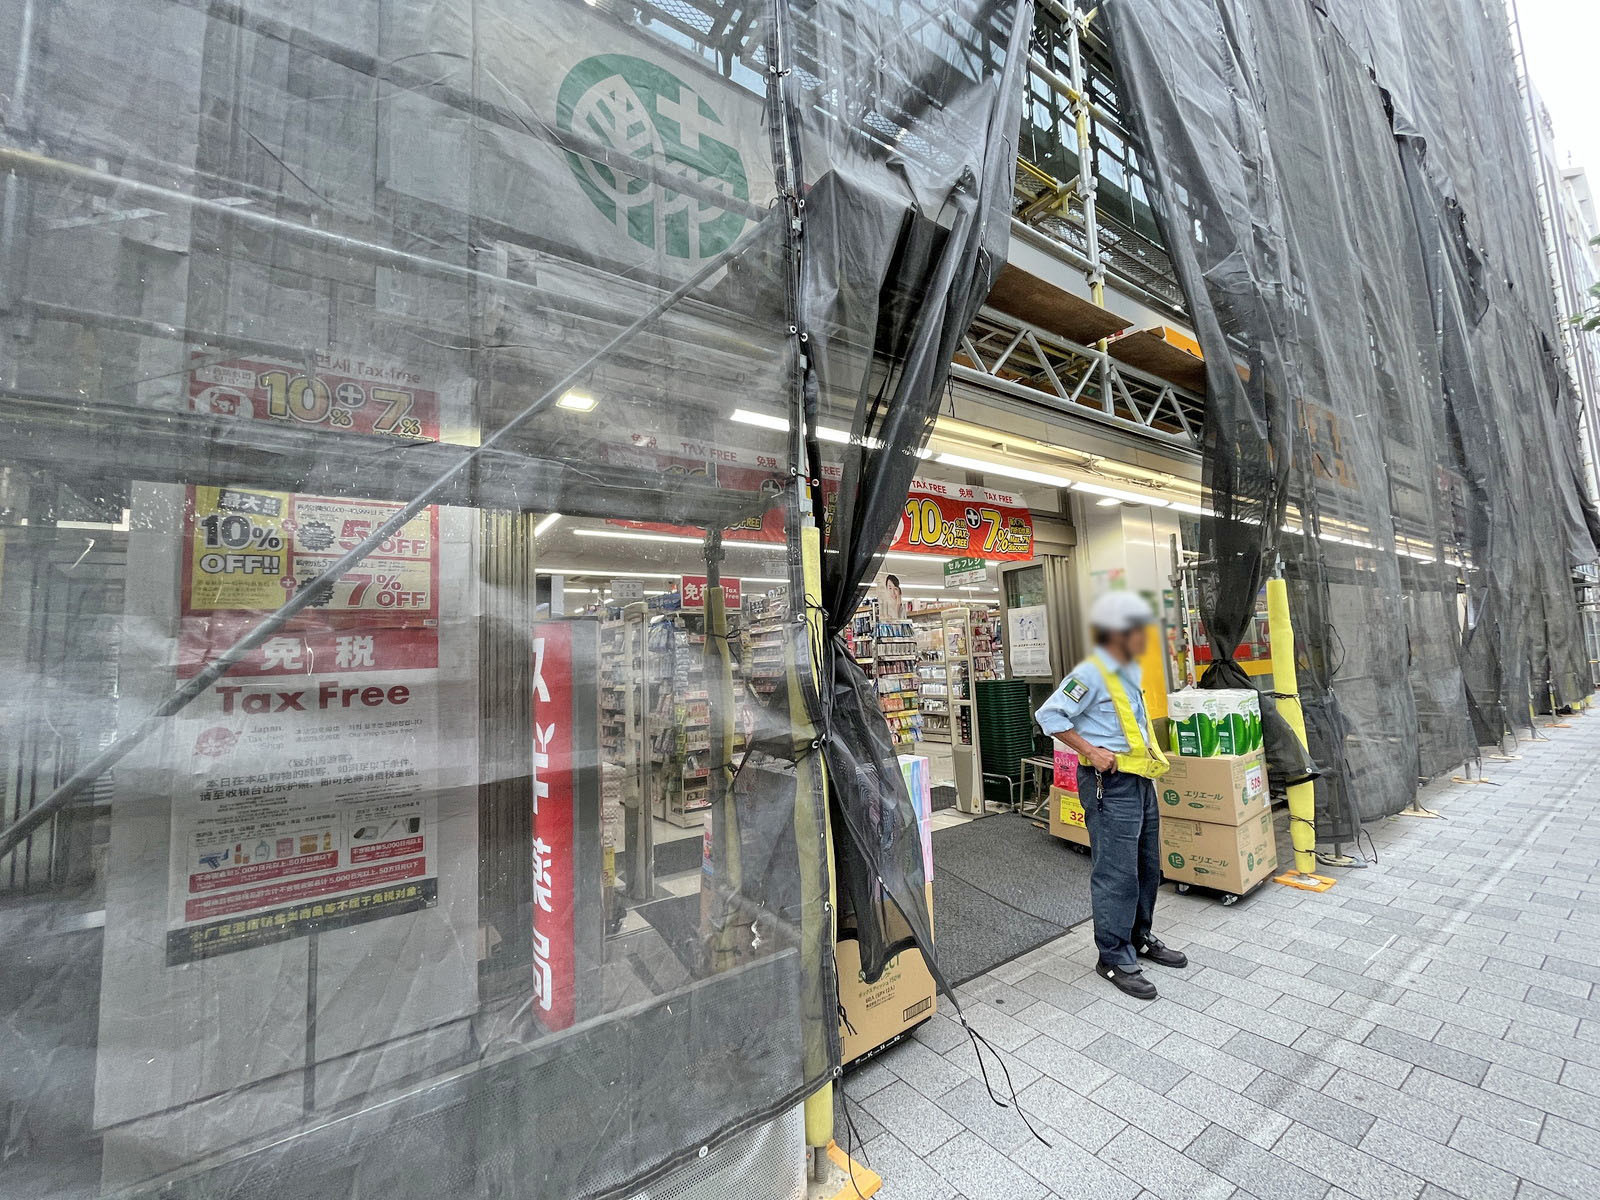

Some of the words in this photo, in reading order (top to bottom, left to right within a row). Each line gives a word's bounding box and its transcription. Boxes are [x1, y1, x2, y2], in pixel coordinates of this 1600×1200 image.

[681, 442, 707, 457] TAX
[710, 448, 737, 462] FREE
[911, 480, 928, 490] TAX
[929, 484, 947, 494] FREE
[984, 491, 998, 501] TAX
[999, 495, 1013, 504] FREE
[202, 515, 283, 550] 10%
[906, 499, 954, 547] 10%
[379, 539, 425, 555] OFF
[201, 554, 281, 575] OFF!!
[338, 573, 403, 607] 7%
[376, 591, 427, 607] OFF
[261, 636, 376, 671] 免税
[216, 686, 306, 717] Tax
[318, 681, 411, 710] Free
[1166, 792, 1178, 801] 12
[1184, 790, 1223, 802] エリエール
[1171, 855, 1182, 864] 12
[1188, 854, 1229, 868] エリエール
